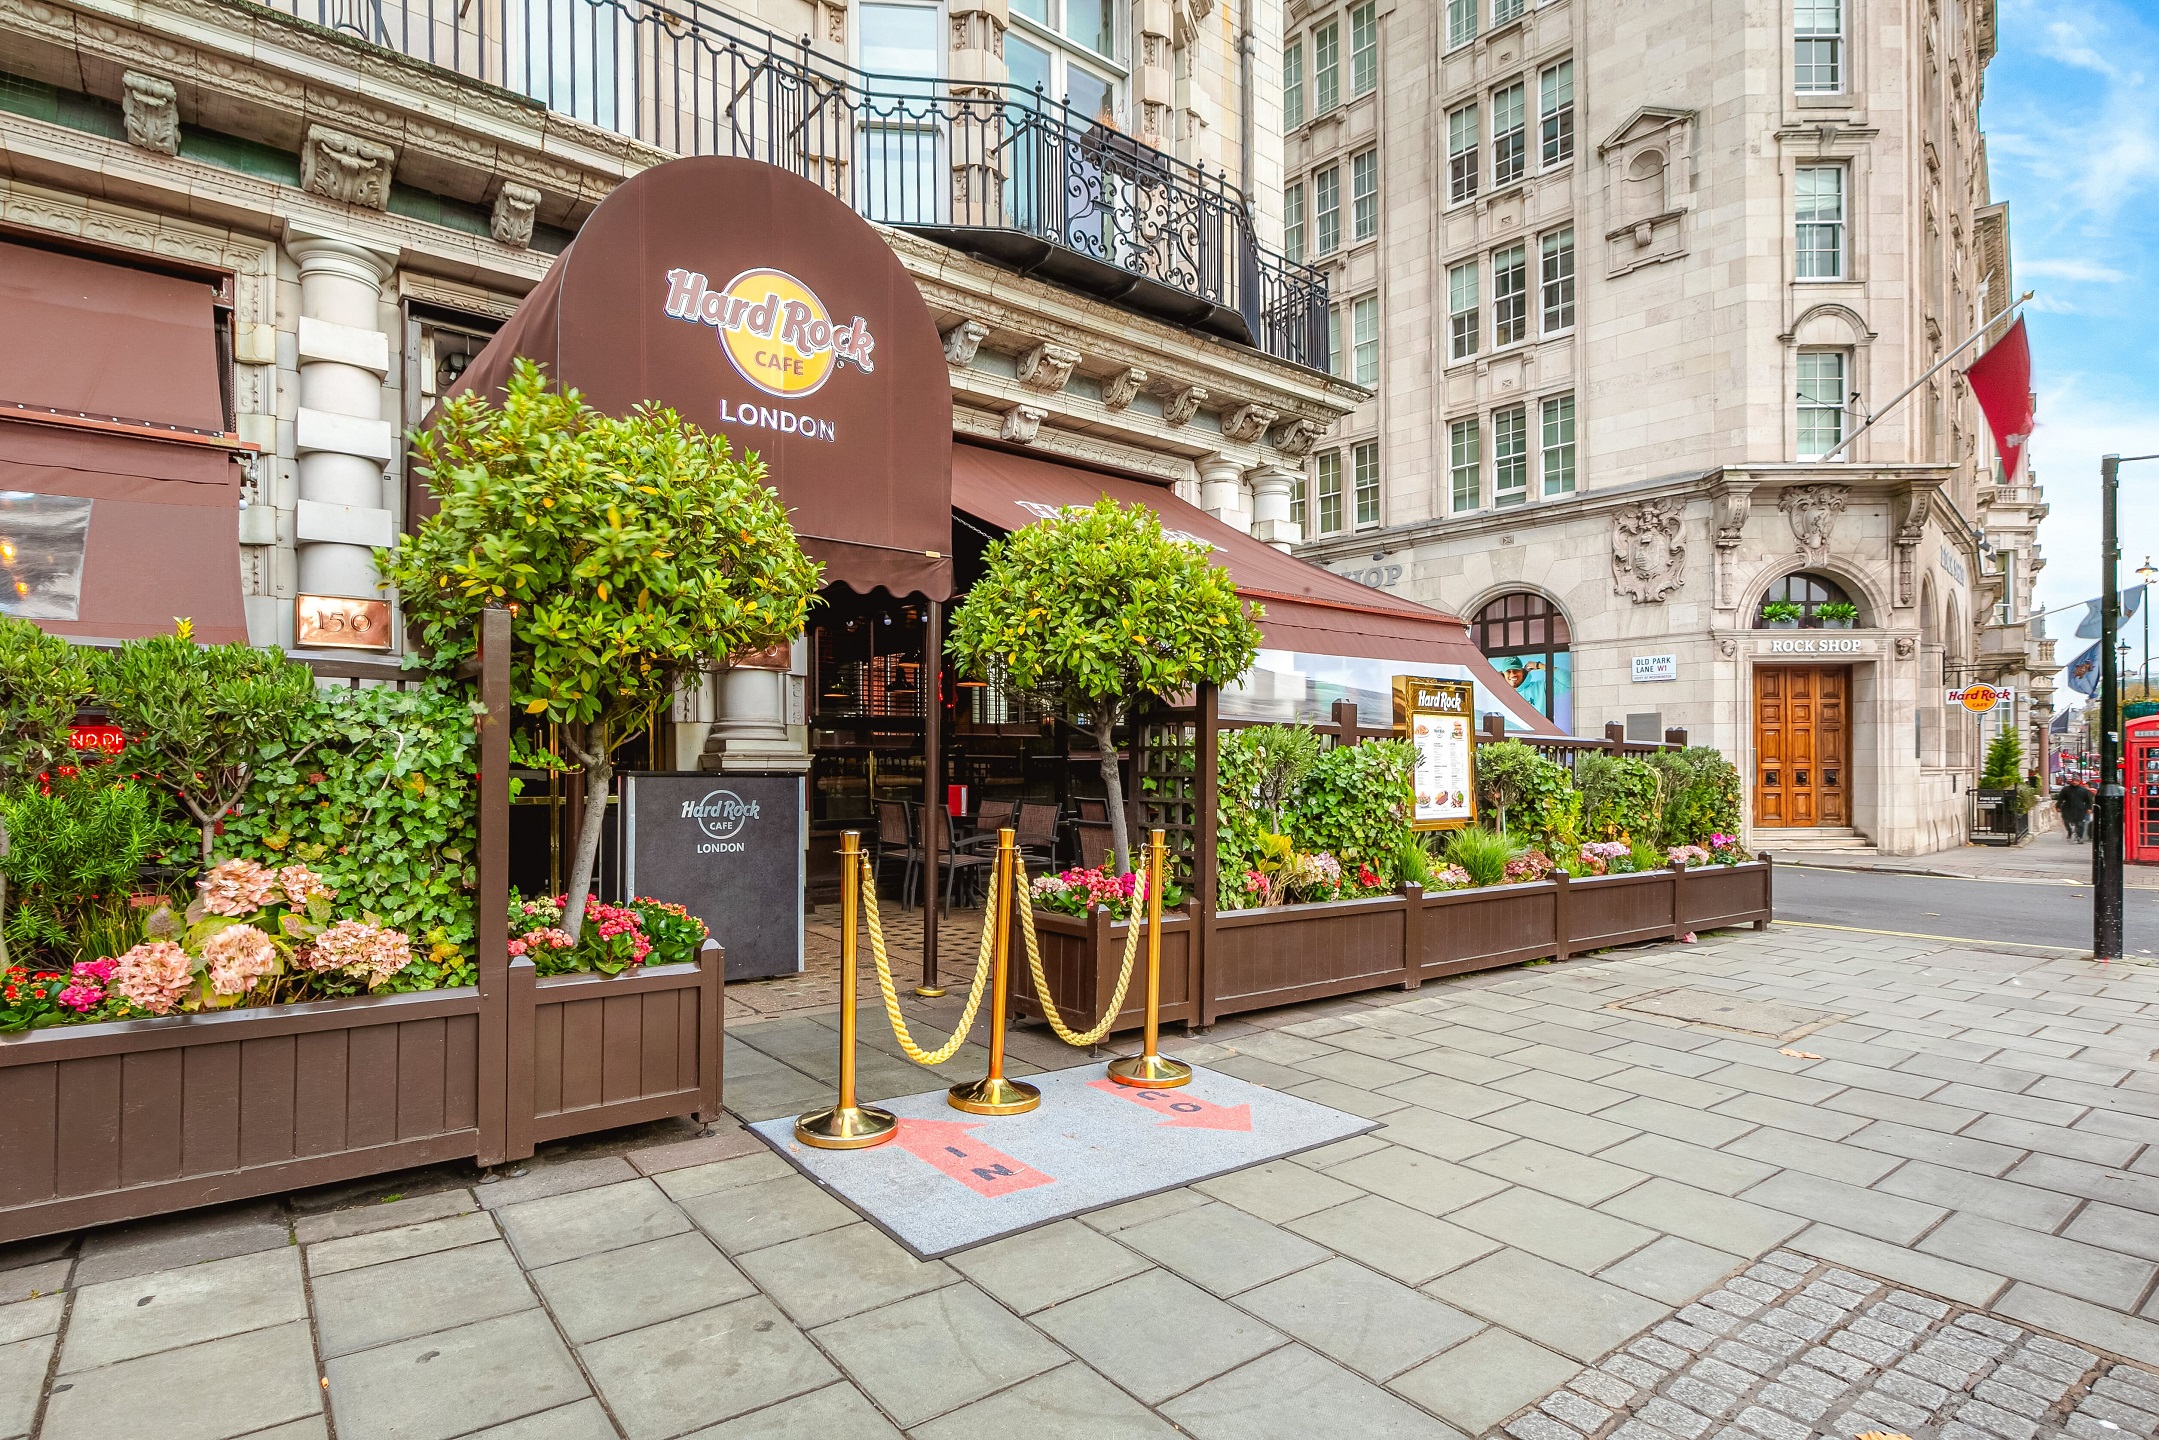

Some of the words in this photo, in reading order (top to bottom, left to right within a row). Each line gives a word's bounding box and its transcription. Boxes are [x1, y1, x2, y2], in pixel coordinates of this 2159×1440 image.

[664, 268, 781, 338] Hard
[781, 299, 875, 374] Rock
[755, 350, 805, 376] CAFE
[719, 399, 836, 442] LONDON
[316, 610, 372, 632] 150
[1771, 639, 1817, 653] ROCK
[1818, 639, 1862, 653] SHOP
[1417, 689, 1440, 708] Hard
[1440, 691, 1462, 712] Rock
[1948, 689, 1980, 702] Hard
[1980, 688, 2012, 702] Rock
[681, 800, 723, 819] Hard
[723, 799, 761, 821] Rock
[709, 821, 733, 831] CAFE
[697, 842, 745, 854] LONDON
[943, 1145, 1012, 1182] IN
